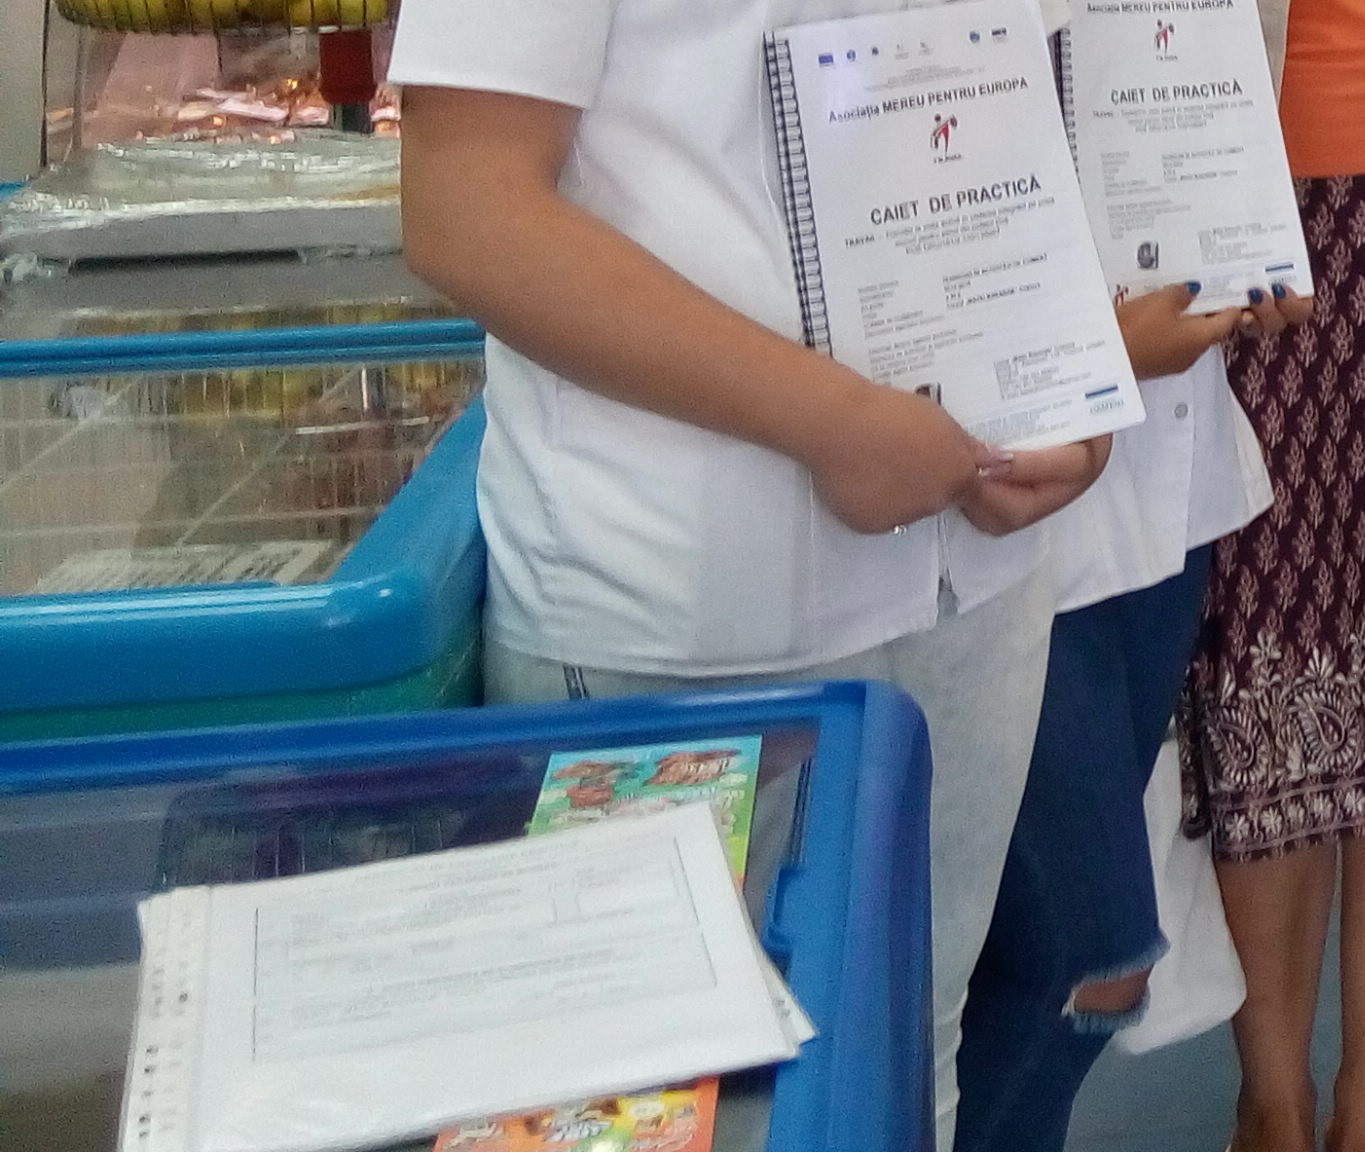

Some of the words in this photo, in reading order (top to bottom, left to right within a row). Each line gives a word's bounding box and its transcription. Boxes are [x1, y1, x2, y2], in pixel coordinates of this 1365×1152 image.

[1152, 0, 1190, 13] PENTRU
[881, 94, 926, 115] MEREU
[928, 85, 977, 107] PENTRU
[978, 76, 1029, 97] EUROPA
[1110, 87, 1146, 106] CAIET
[1152, 85, 1171, 103] DE
[869, 199, 920, 226] CAIET
[928, 192, 954, 215] DE
